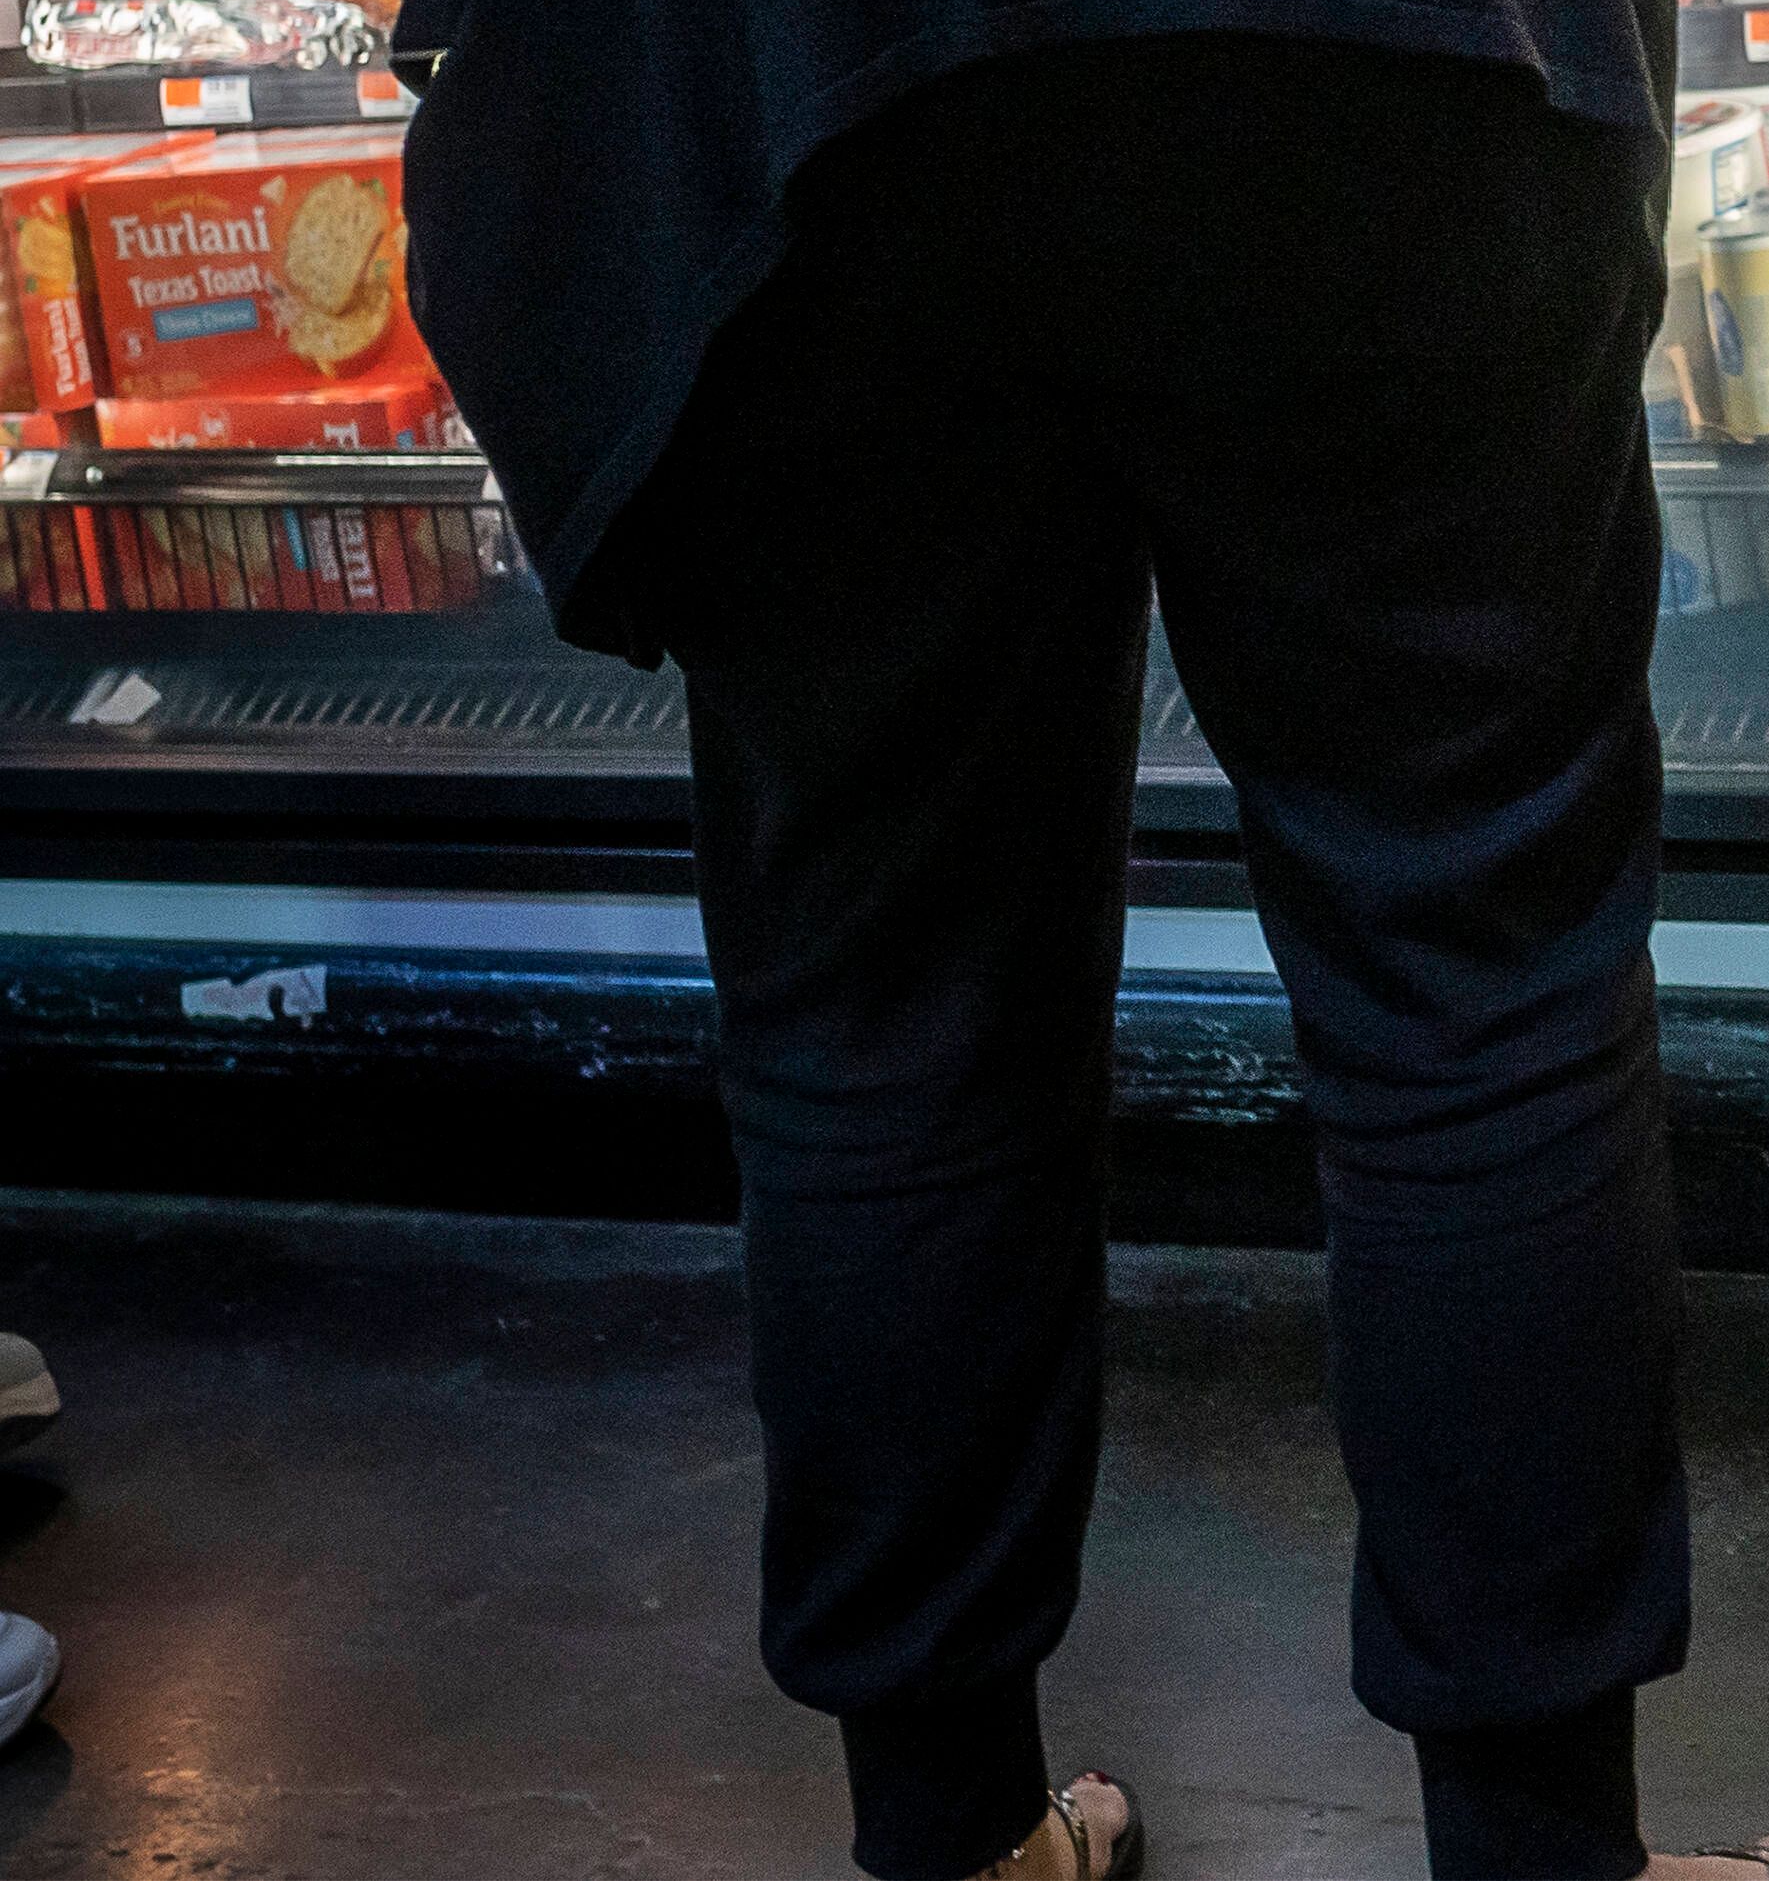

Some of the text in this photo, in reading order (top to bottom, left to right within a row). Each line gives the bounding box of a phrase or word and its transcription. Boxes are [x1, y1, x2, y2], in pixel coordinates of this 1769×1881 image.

[109, 205, 271, 261] Furlani
[127, 263, 264, 309] Texas Toast
